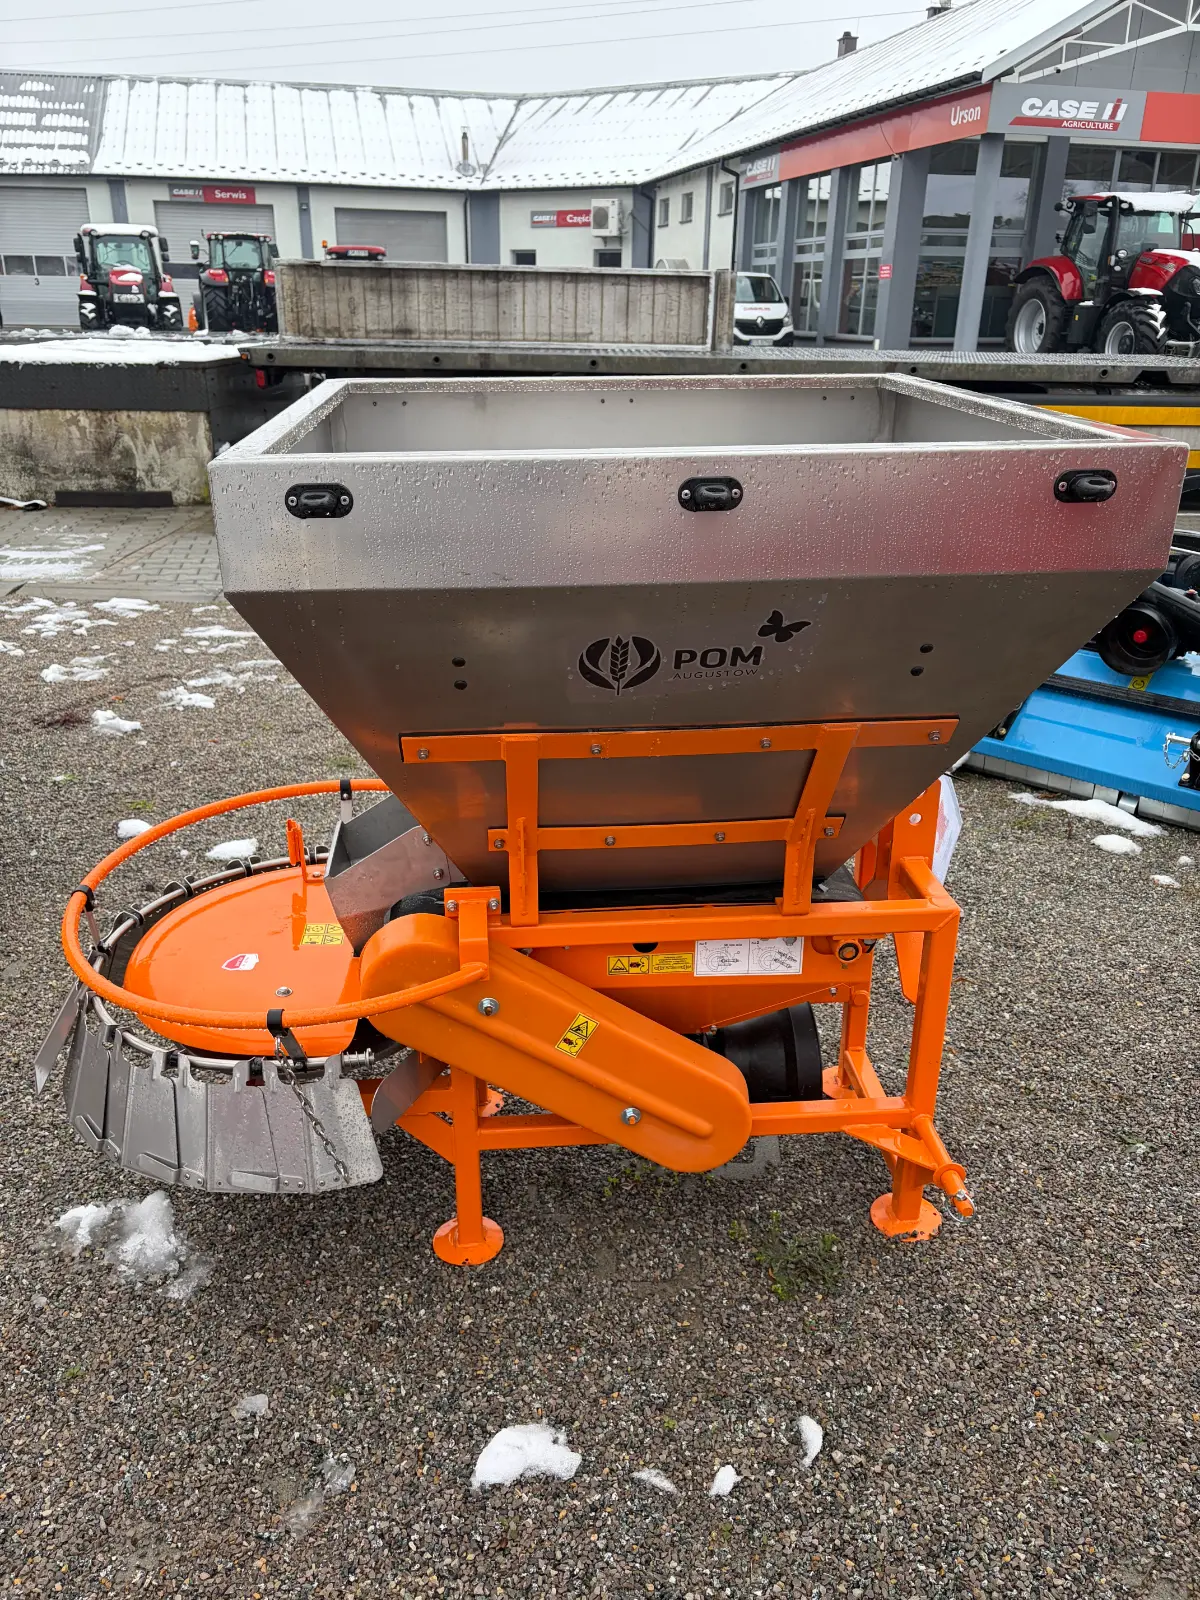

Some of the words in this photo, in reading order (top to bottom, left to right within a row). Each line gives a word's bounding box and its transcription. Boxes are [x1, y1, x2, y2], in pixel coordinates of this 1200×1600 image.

[950, 105, 982, 127] Urson
[1021, 97, 1100, 120] CASE
[1061, 120, 1114, 130] AGRICULTURE
[214, 189, 248, 200] Serwis
[34, 278, 40, 286] 3
[673, 646, 763, 670] POM
